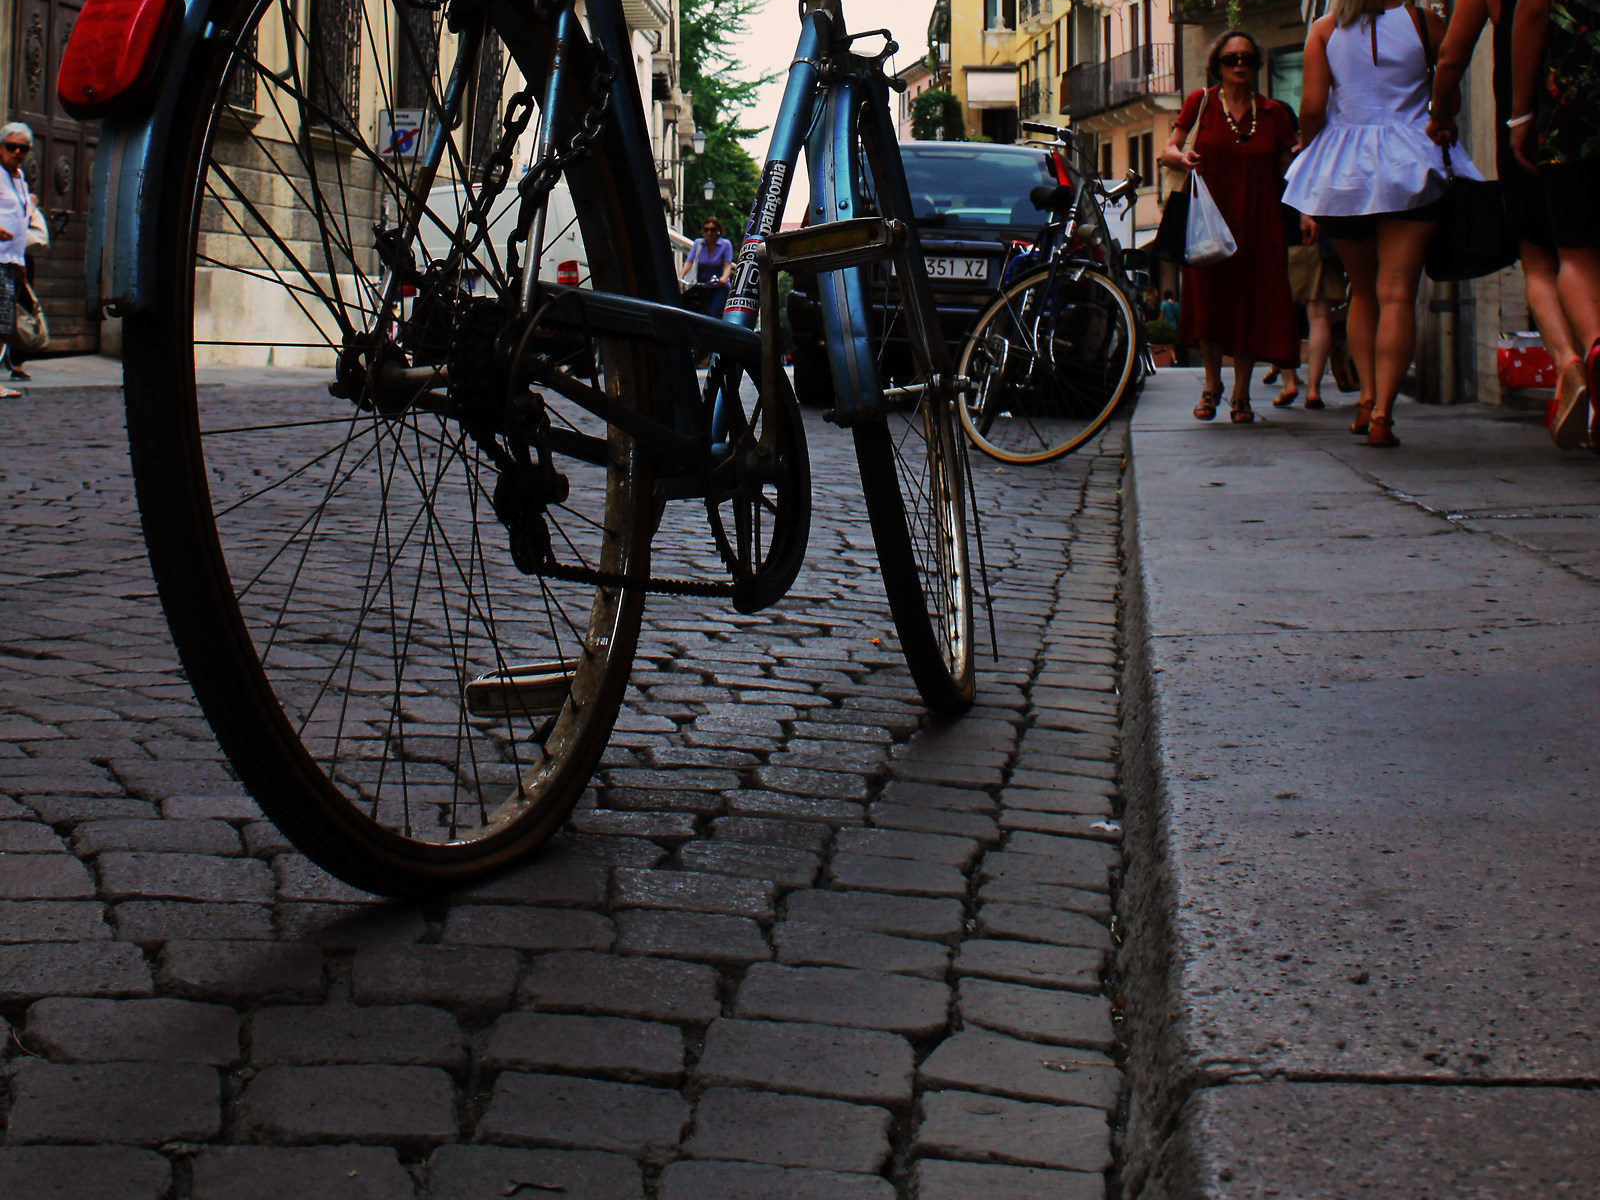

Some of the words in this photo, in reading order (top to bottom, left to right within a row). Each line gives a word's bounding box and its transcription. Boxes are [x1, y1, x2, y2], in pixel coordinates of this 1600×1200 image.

[760, 163, 787, 237] patagonia
[926, 259, 955, 276] 351
[964, 260, 985, 278] XZ
